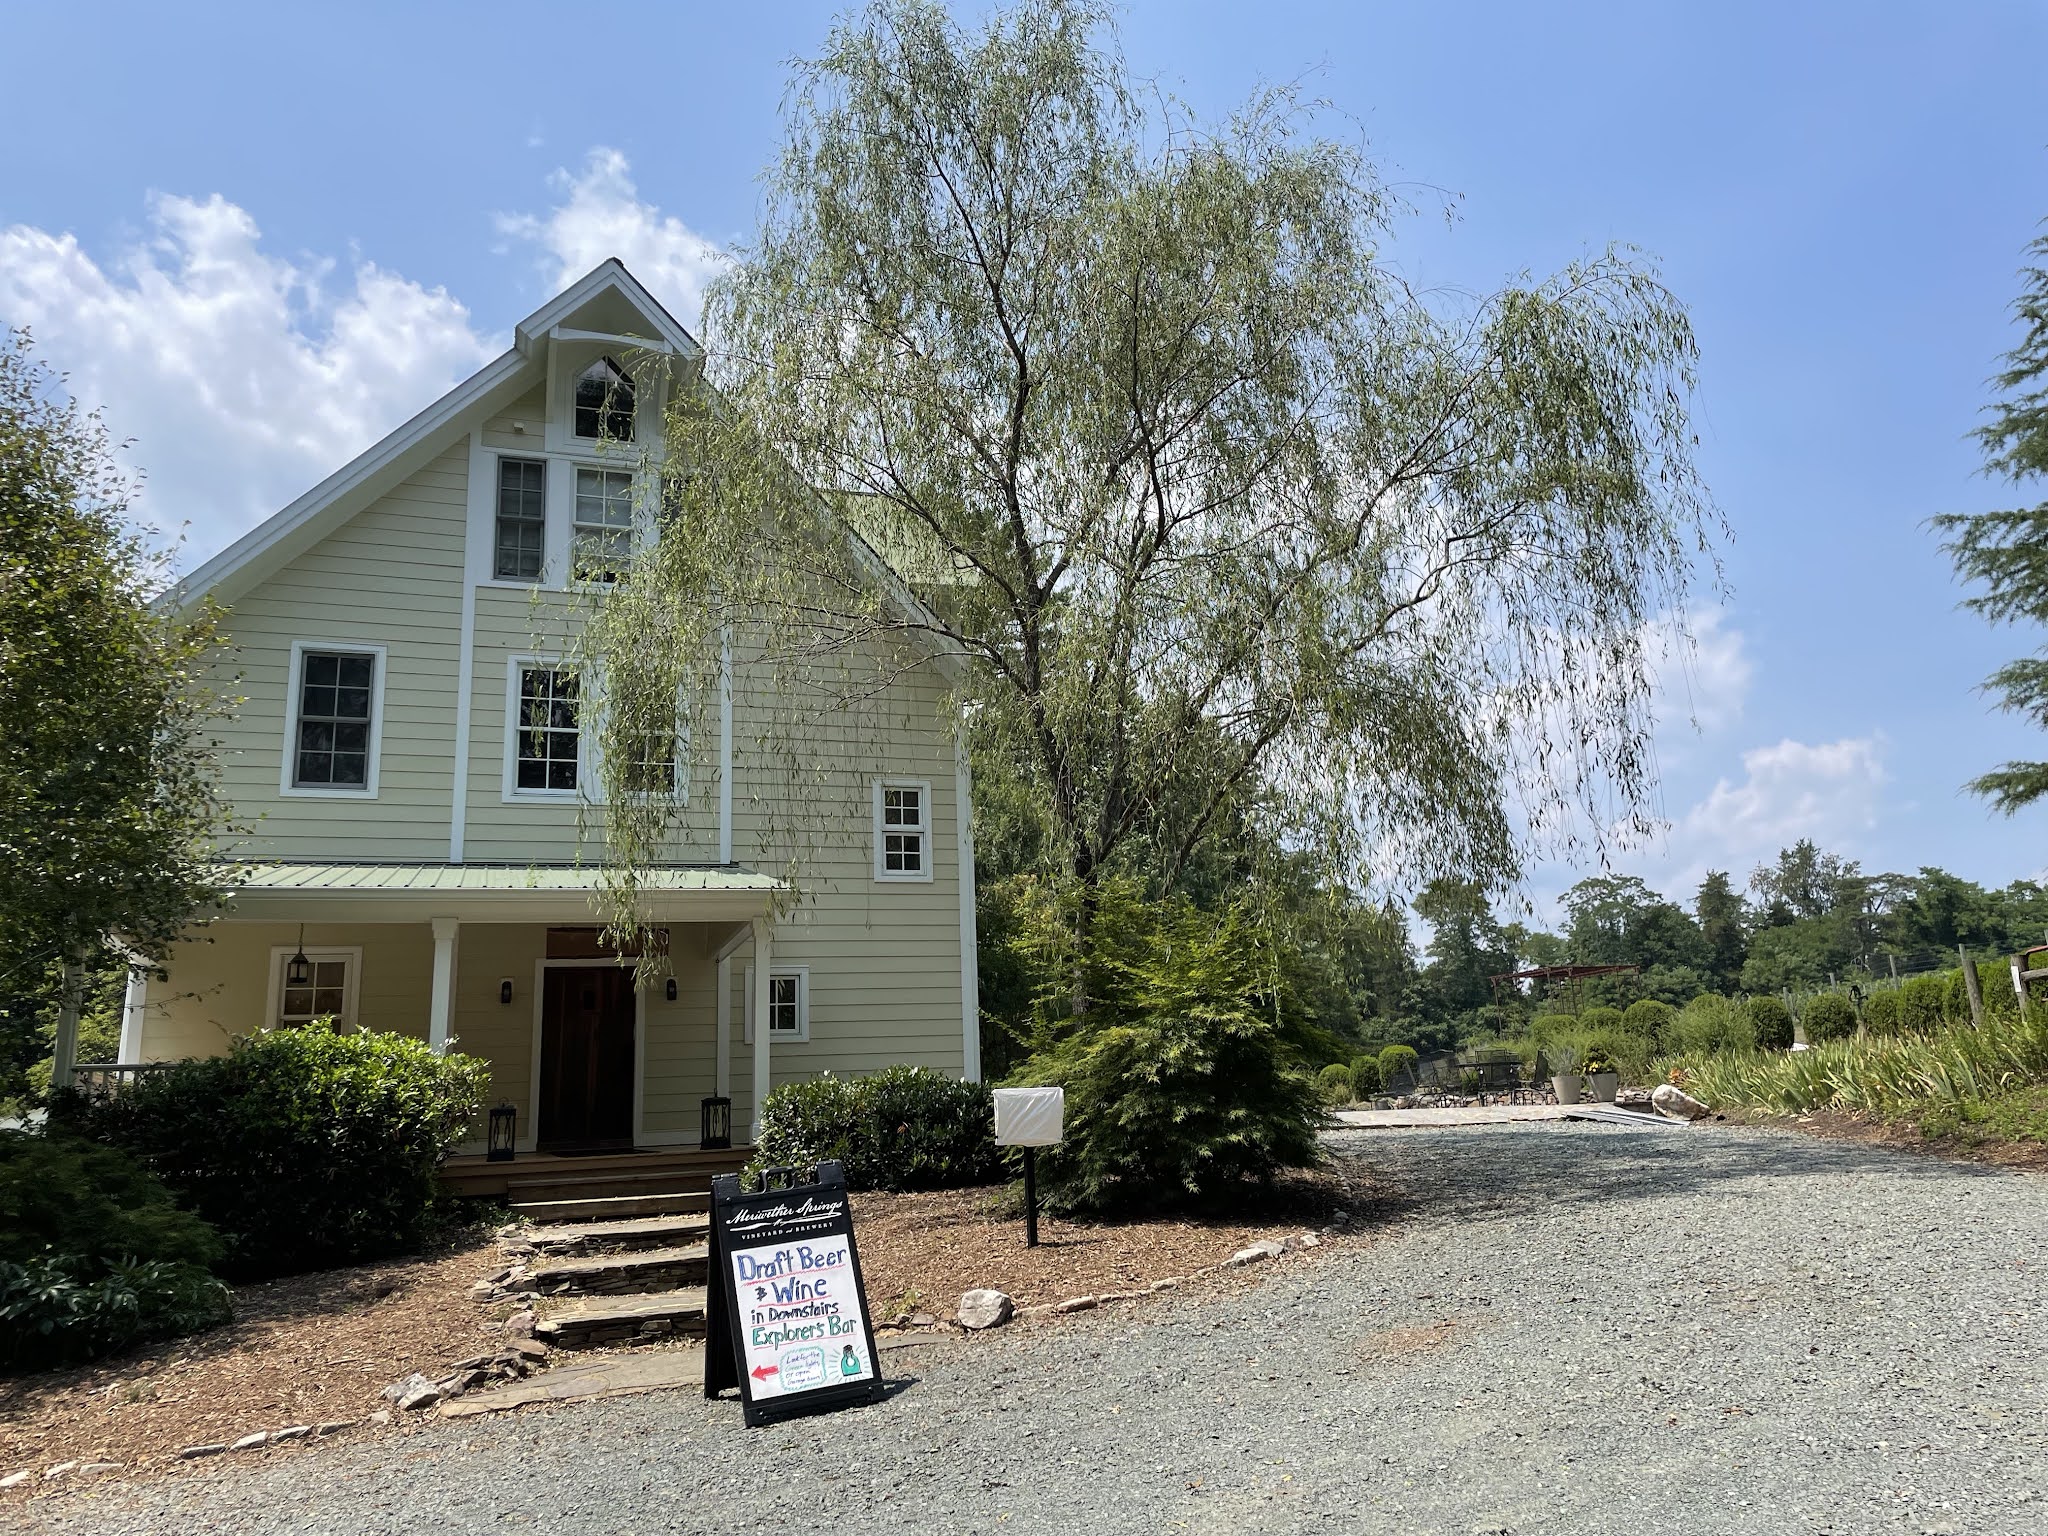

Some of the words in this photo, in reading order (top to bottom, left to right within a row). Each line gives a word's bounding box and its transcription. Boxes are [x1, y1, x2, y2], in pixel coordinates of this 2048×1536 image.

[726, 1203, 794, 1225] Meriwether
[796, 1197, 843, 1216] Springs
[741, 1229, 783, 1240] VINEYARD
[795, 1221, 833, 1233] BREWERY
[737, 1249, 793, 1281] Draft
[797, 1246, 847, 1270] Beer
[771, 1277, 827, 1303] Wine
[750, 1309, 765, 1324] in
[769, 1301, 839, 1321] Downstairs
[827, 1314, 857, 1336] Bar
